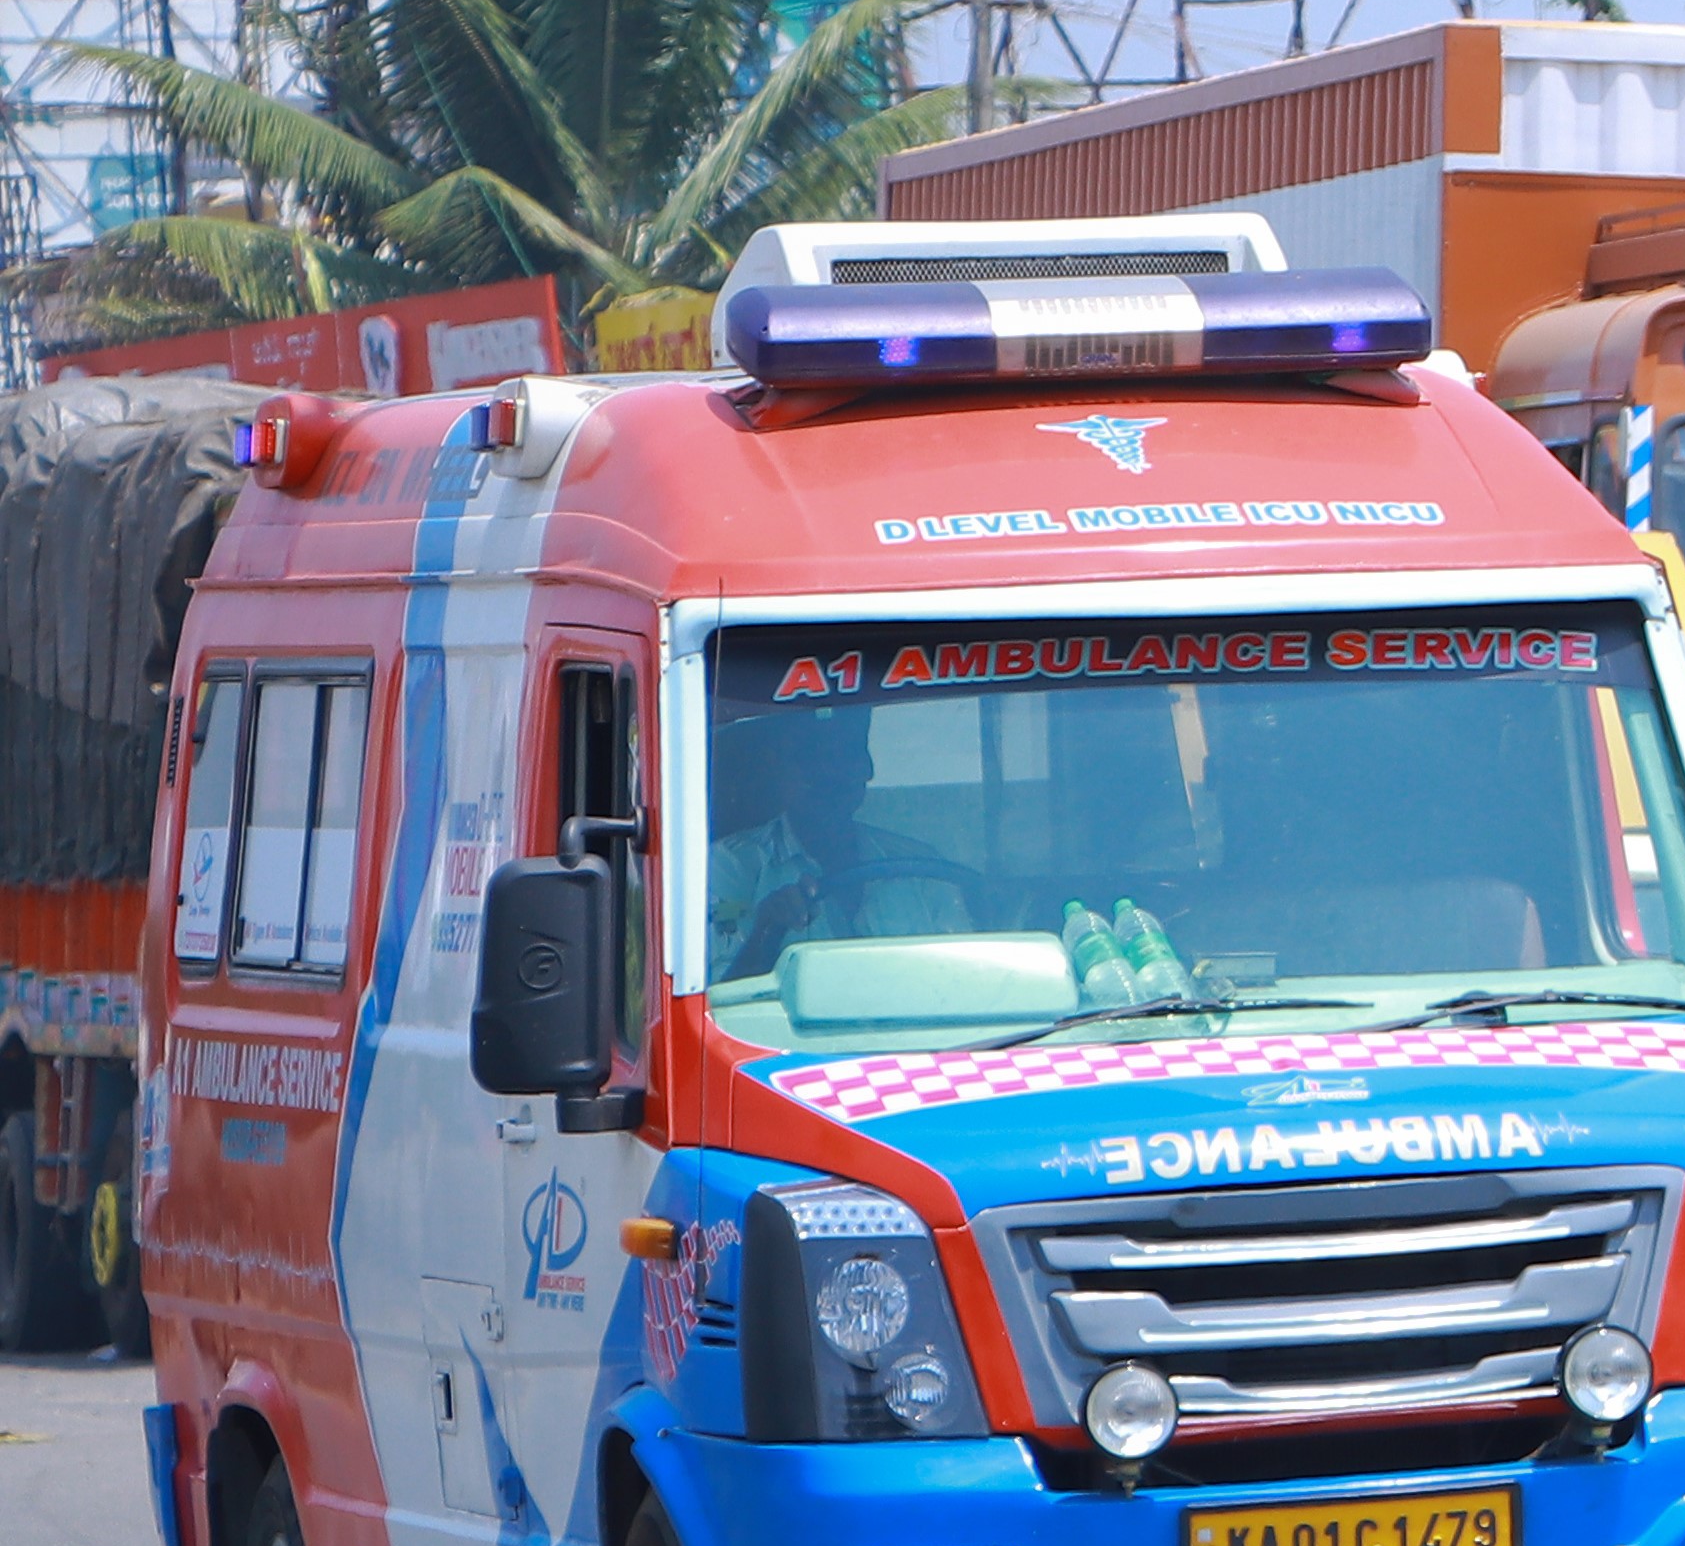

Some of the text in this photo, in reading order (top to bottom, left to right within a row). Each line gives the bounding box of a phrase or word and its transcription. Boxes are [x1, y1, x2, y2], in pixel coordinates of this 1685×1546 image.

[880, 500, 1442, 543] D LEVEL MOBILE ICU NICU
[776, 628, 1599, 701] A1 AMBULANCE SERVICE
[191, 1040, 279, 1106] AMBULANCE
[278, 1045, 342, 1113] SERVICE
